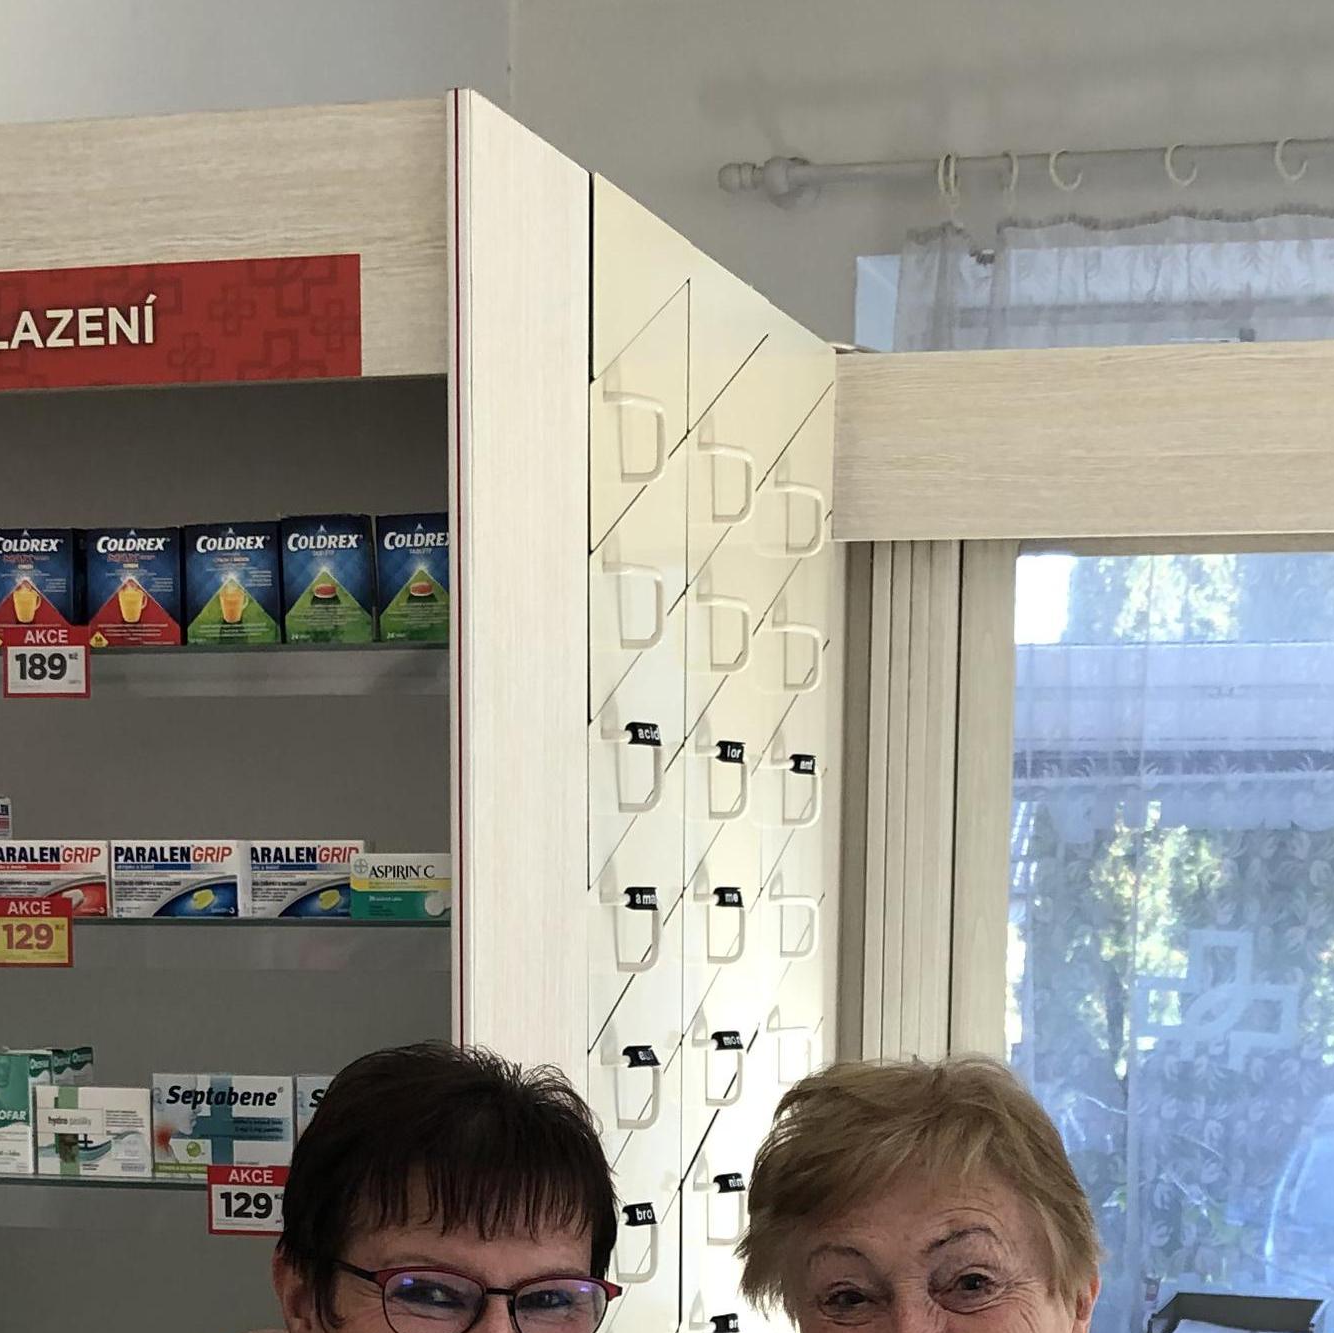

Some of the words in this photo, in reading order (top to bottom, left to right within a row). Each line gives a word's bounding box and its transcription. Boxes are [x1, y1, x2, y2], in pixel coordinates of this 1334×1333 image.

[96, 537, 166, 554] COLDREX
[197, 536, 266, 554] COLDREX
[287, 533, 358, 551] COLDREX
[24, 629, 69, 644] AKCE
[15, 653, 67, 680] 189
[62, 847, 101, 864] GRIP
[114, 847, 192, 864] PARALEN
[193, 847, 233, 864] GRIP
[369, 865, 422, 880] ASPIRIN
[424, 865, 435, 878] C
[6, 902, 52, 916] AKCE
[2, 924, 54, 950] 129
[166, 1085, 278, 1110] Septabene
[219, 1192, 273, 1219] 129
